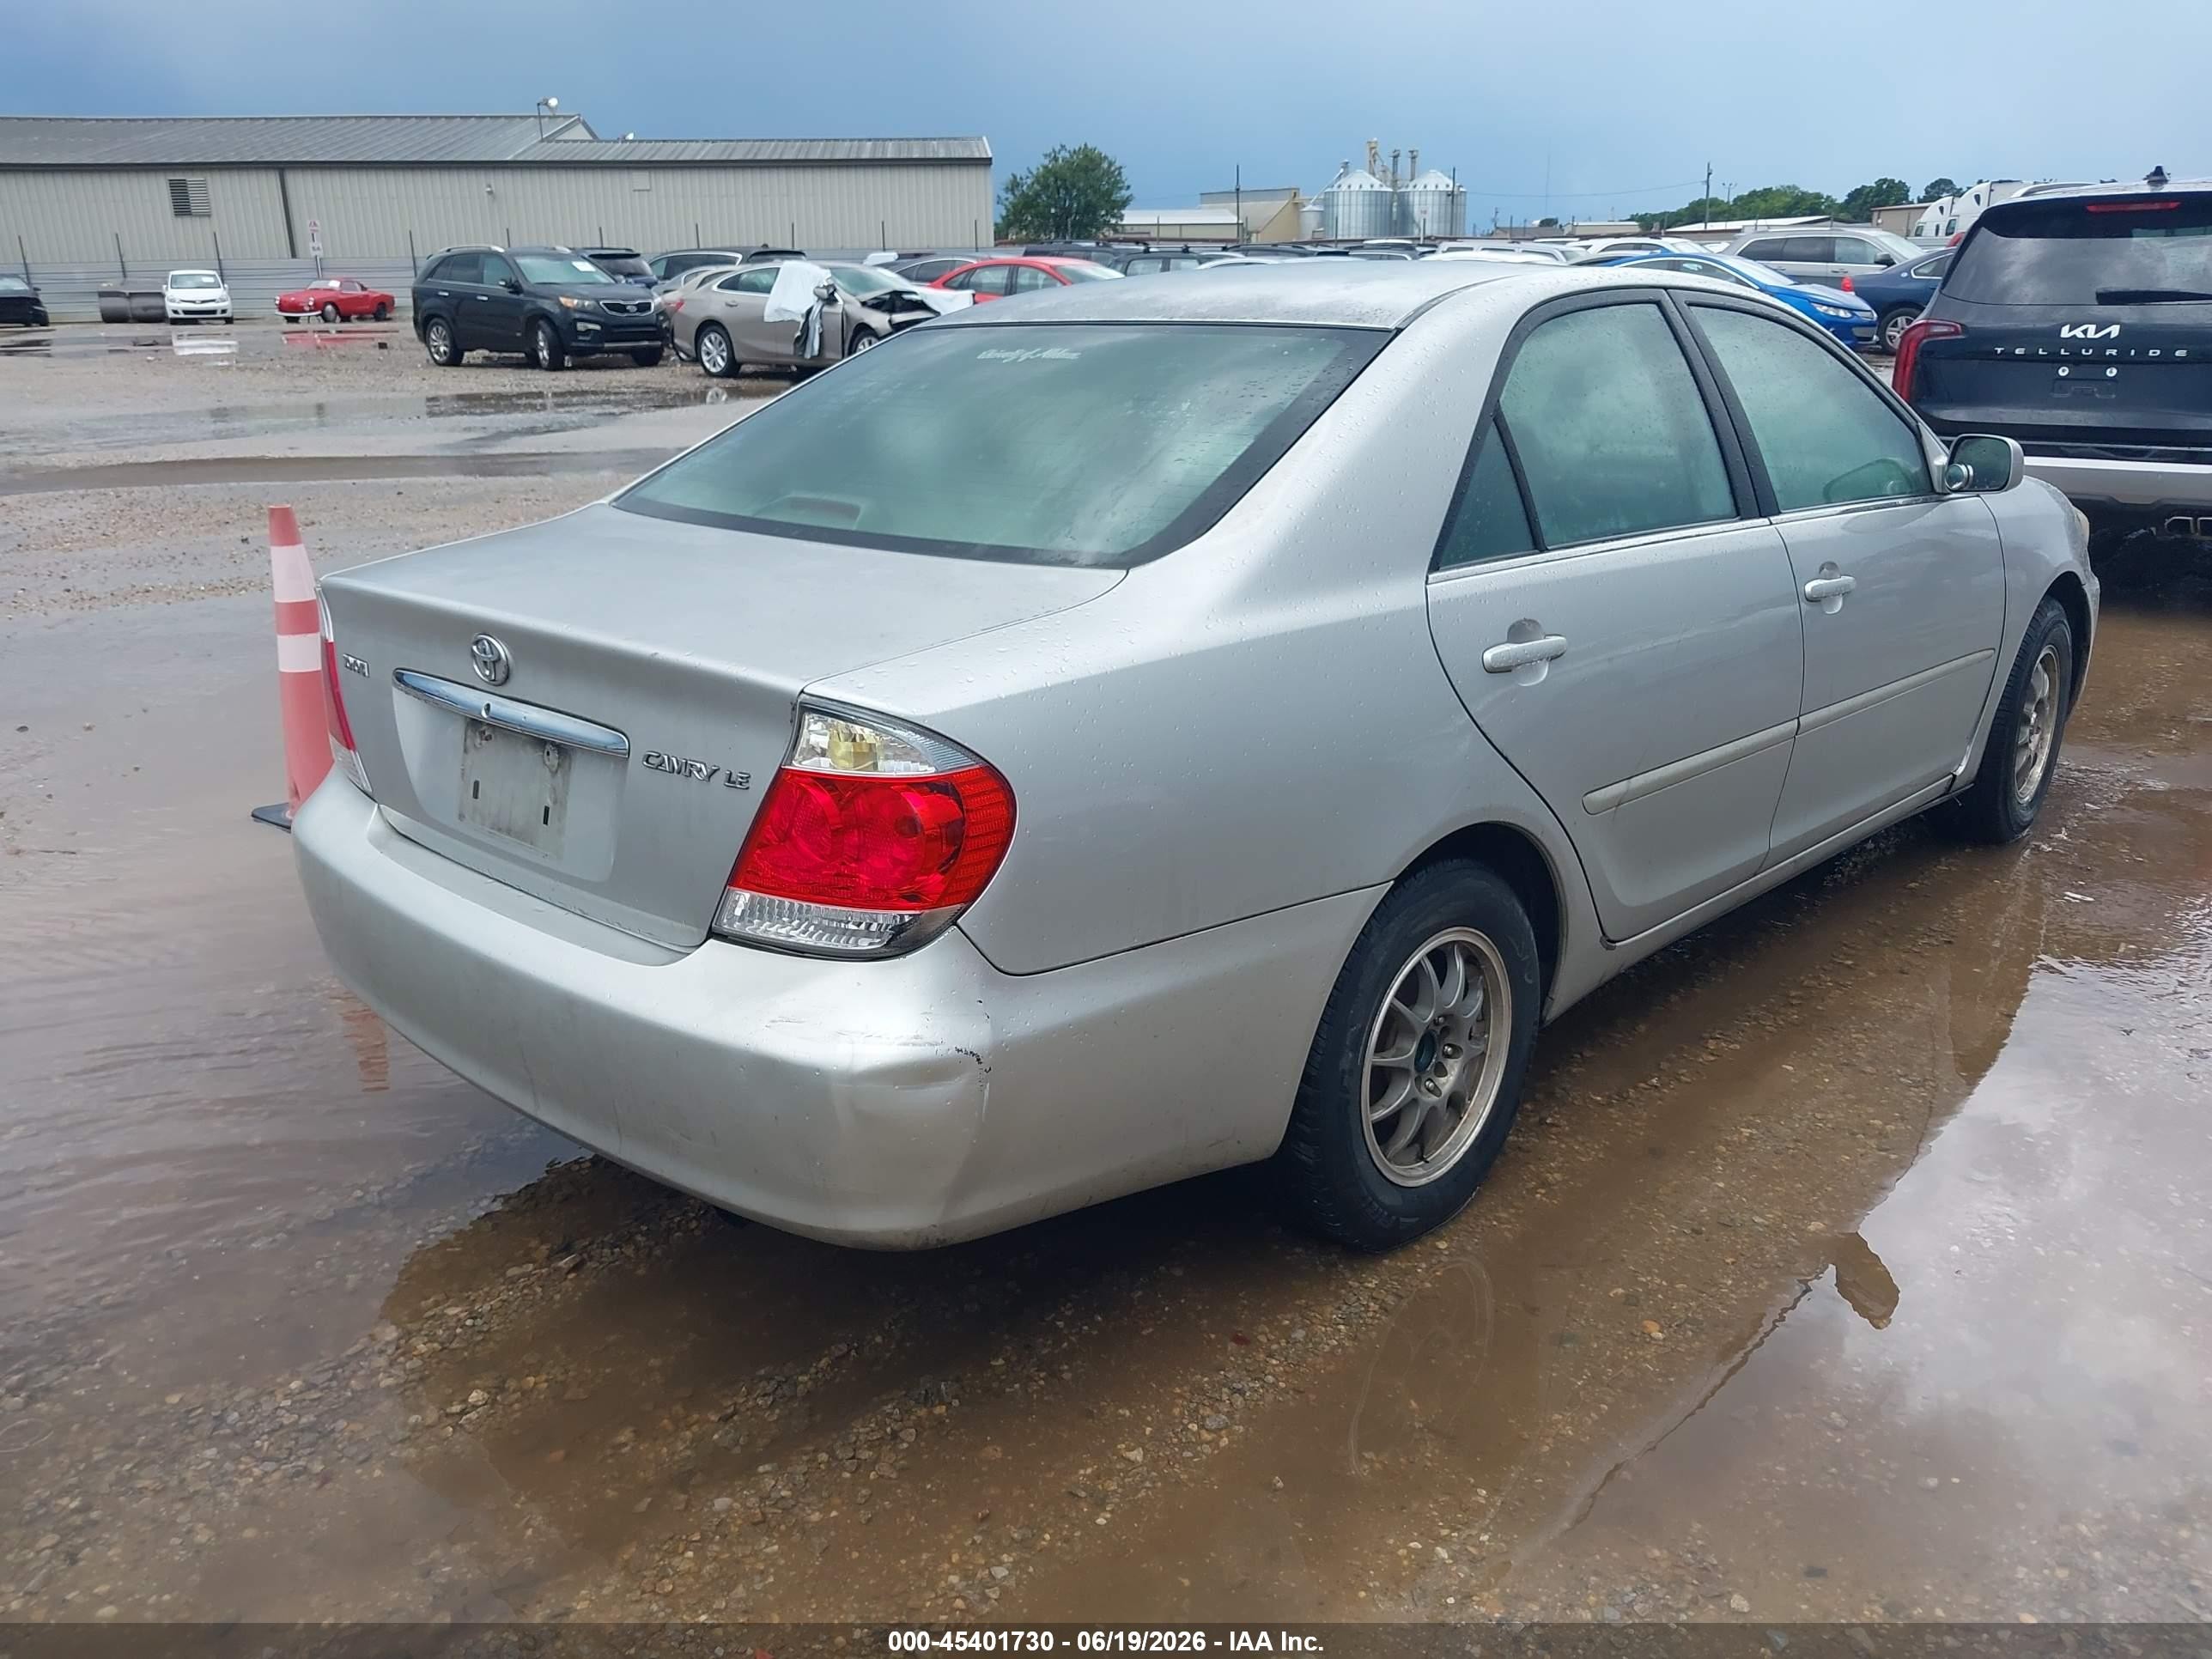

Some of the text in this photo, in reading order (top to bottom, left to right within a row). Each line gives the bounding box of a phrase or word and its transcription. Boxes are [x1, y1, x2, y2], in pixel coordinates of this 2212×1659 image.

[2060, 324, 2121, 338] KIA
[1994, 347, 2189, 357] TELLURIDE
[642, 750, 751, 790] CAMRY LE
